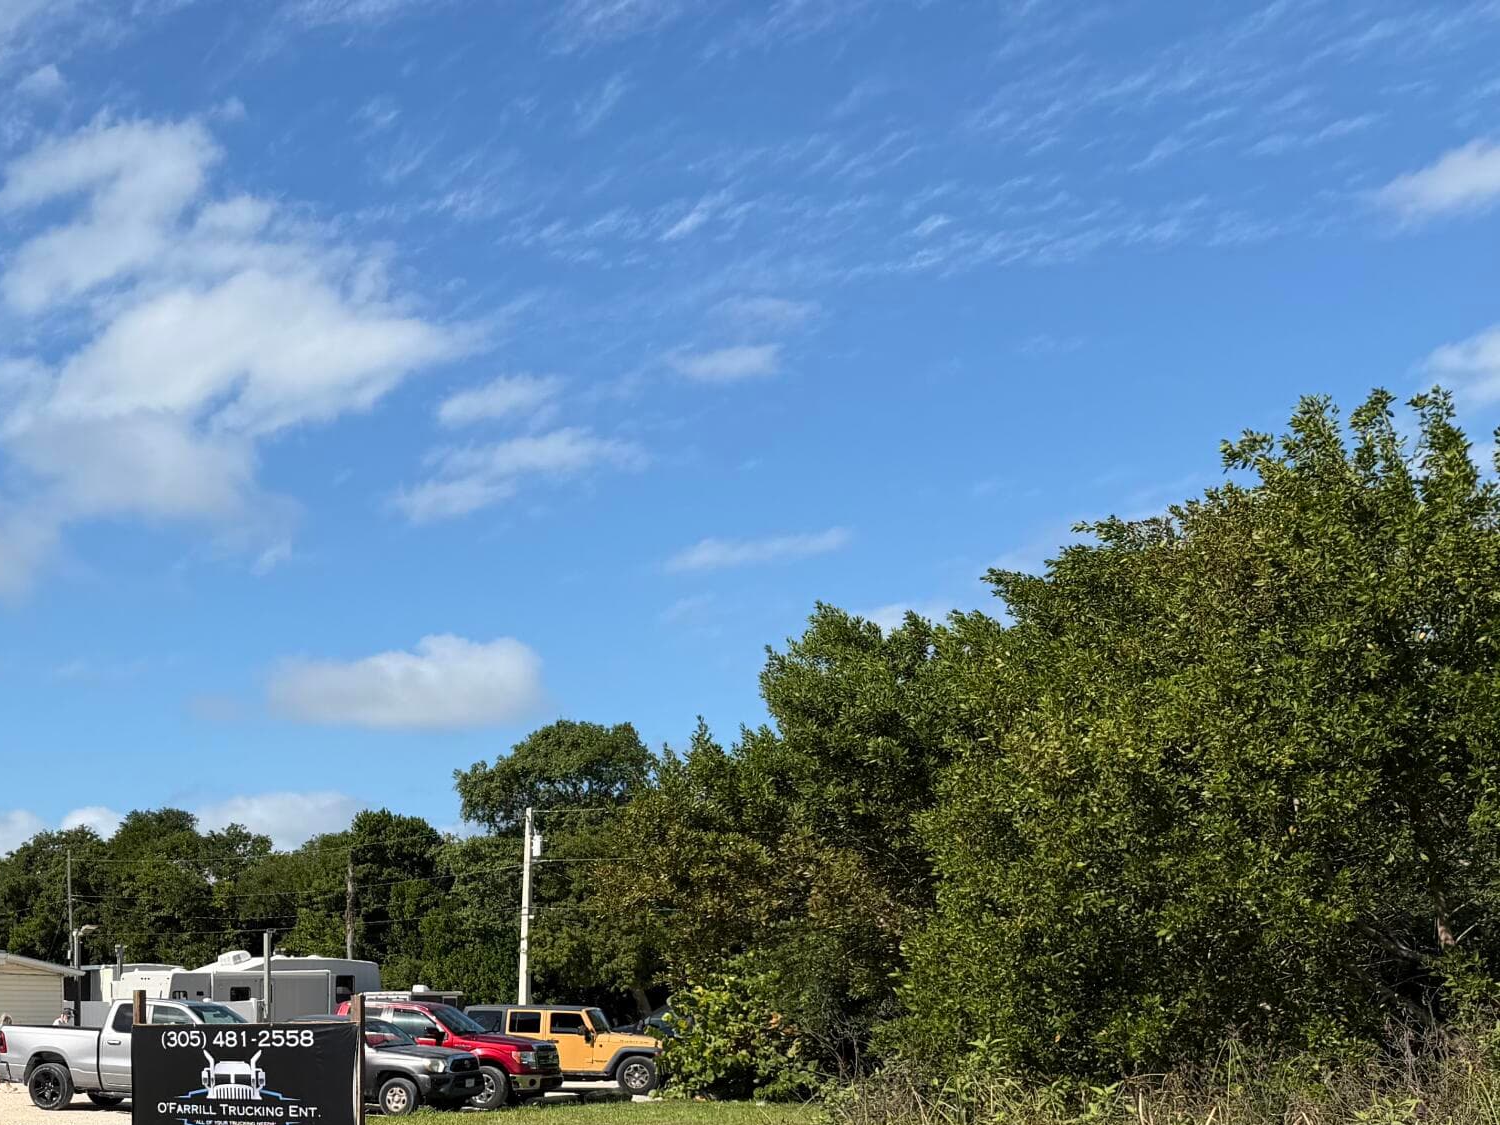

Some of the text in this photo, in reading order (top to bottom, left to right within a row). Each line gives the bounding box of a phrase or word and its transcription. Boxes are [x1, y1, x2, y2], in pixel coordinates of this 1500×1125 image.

[162, 1030, 314, 1049] (305) 481-2558
[158, 1102, 321, 1118] O'FARRILL TRUCKING ENT.
